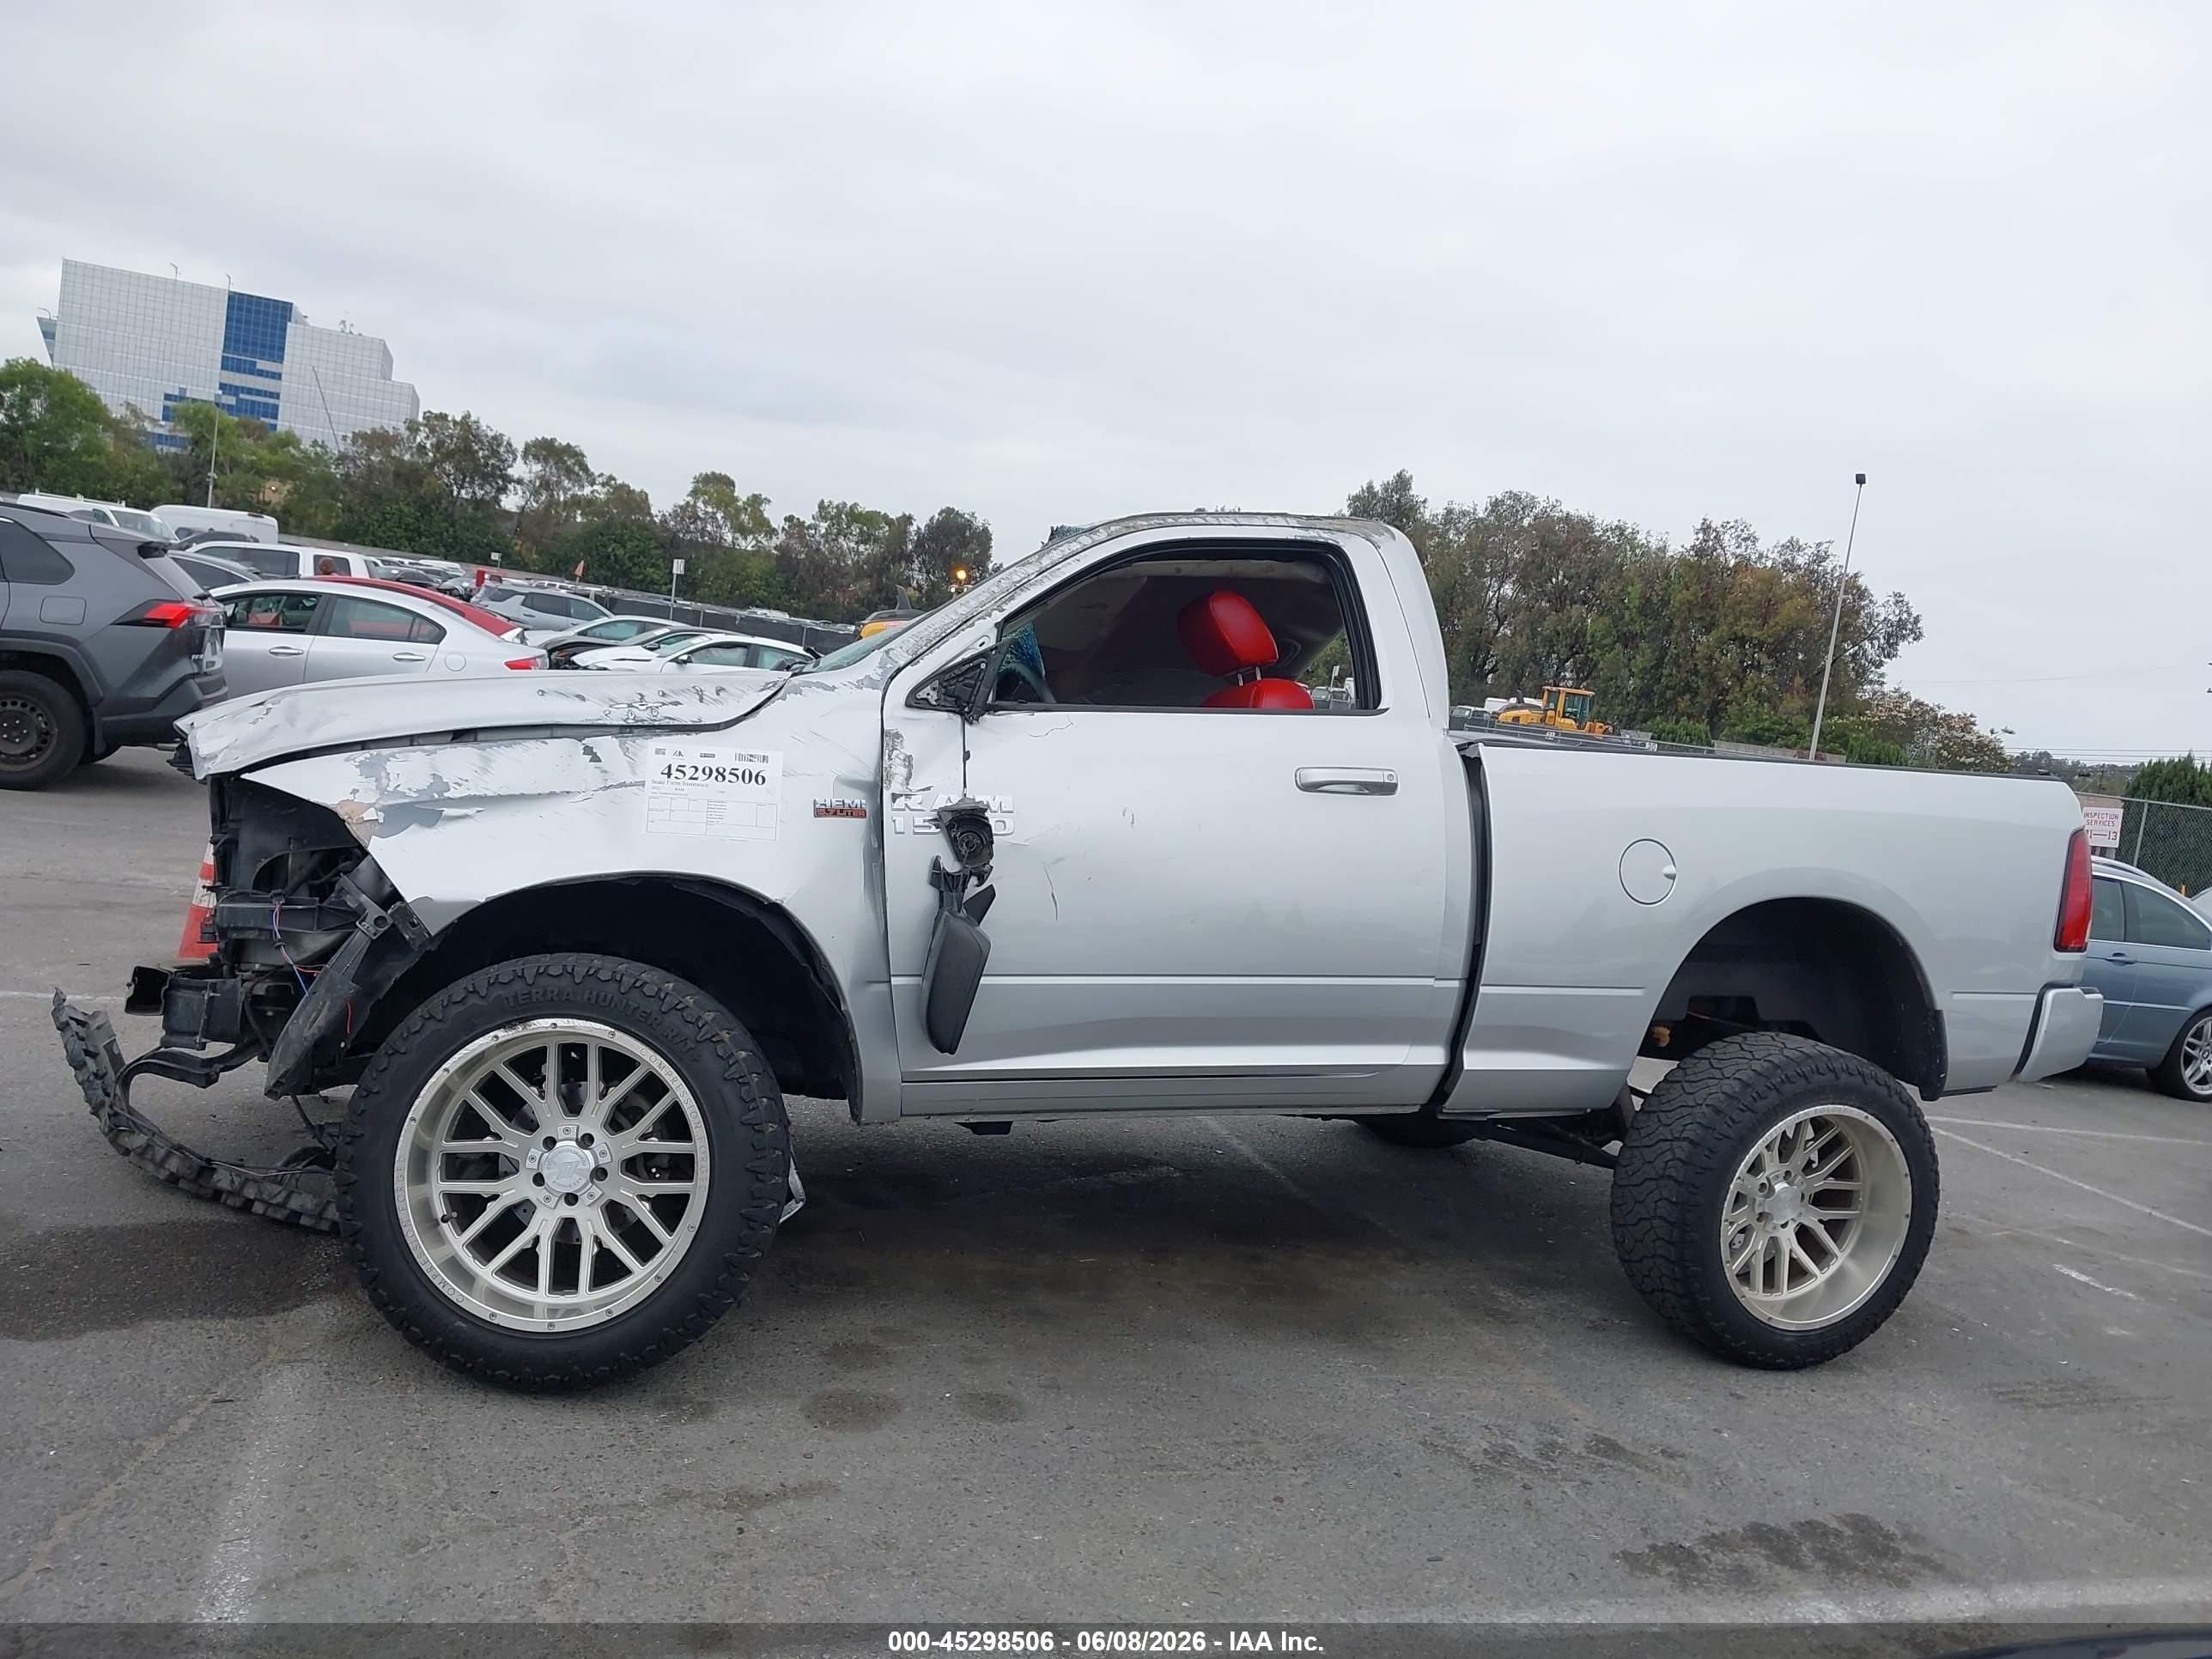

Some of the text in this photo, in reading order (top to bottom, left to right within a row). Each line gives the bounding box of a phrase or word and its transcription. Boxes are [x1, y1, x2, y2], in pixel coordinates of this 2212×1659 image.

[660, 763, 766, 786] 45298506
[814, 798, 866, 808] HEMI
[890, 792, 1015, 814] RAM
[891, 815, 1015, 836] 150
[2084, 811, 2119, 820] INSPECTION
[505, 988, 576, 1008] TERRA
[583, 991, 663, 1028] HUNTER
[640, 1047, 703, 1131] COMPRESSION
[401, 1219, 465, 1304] COMPRESSION
